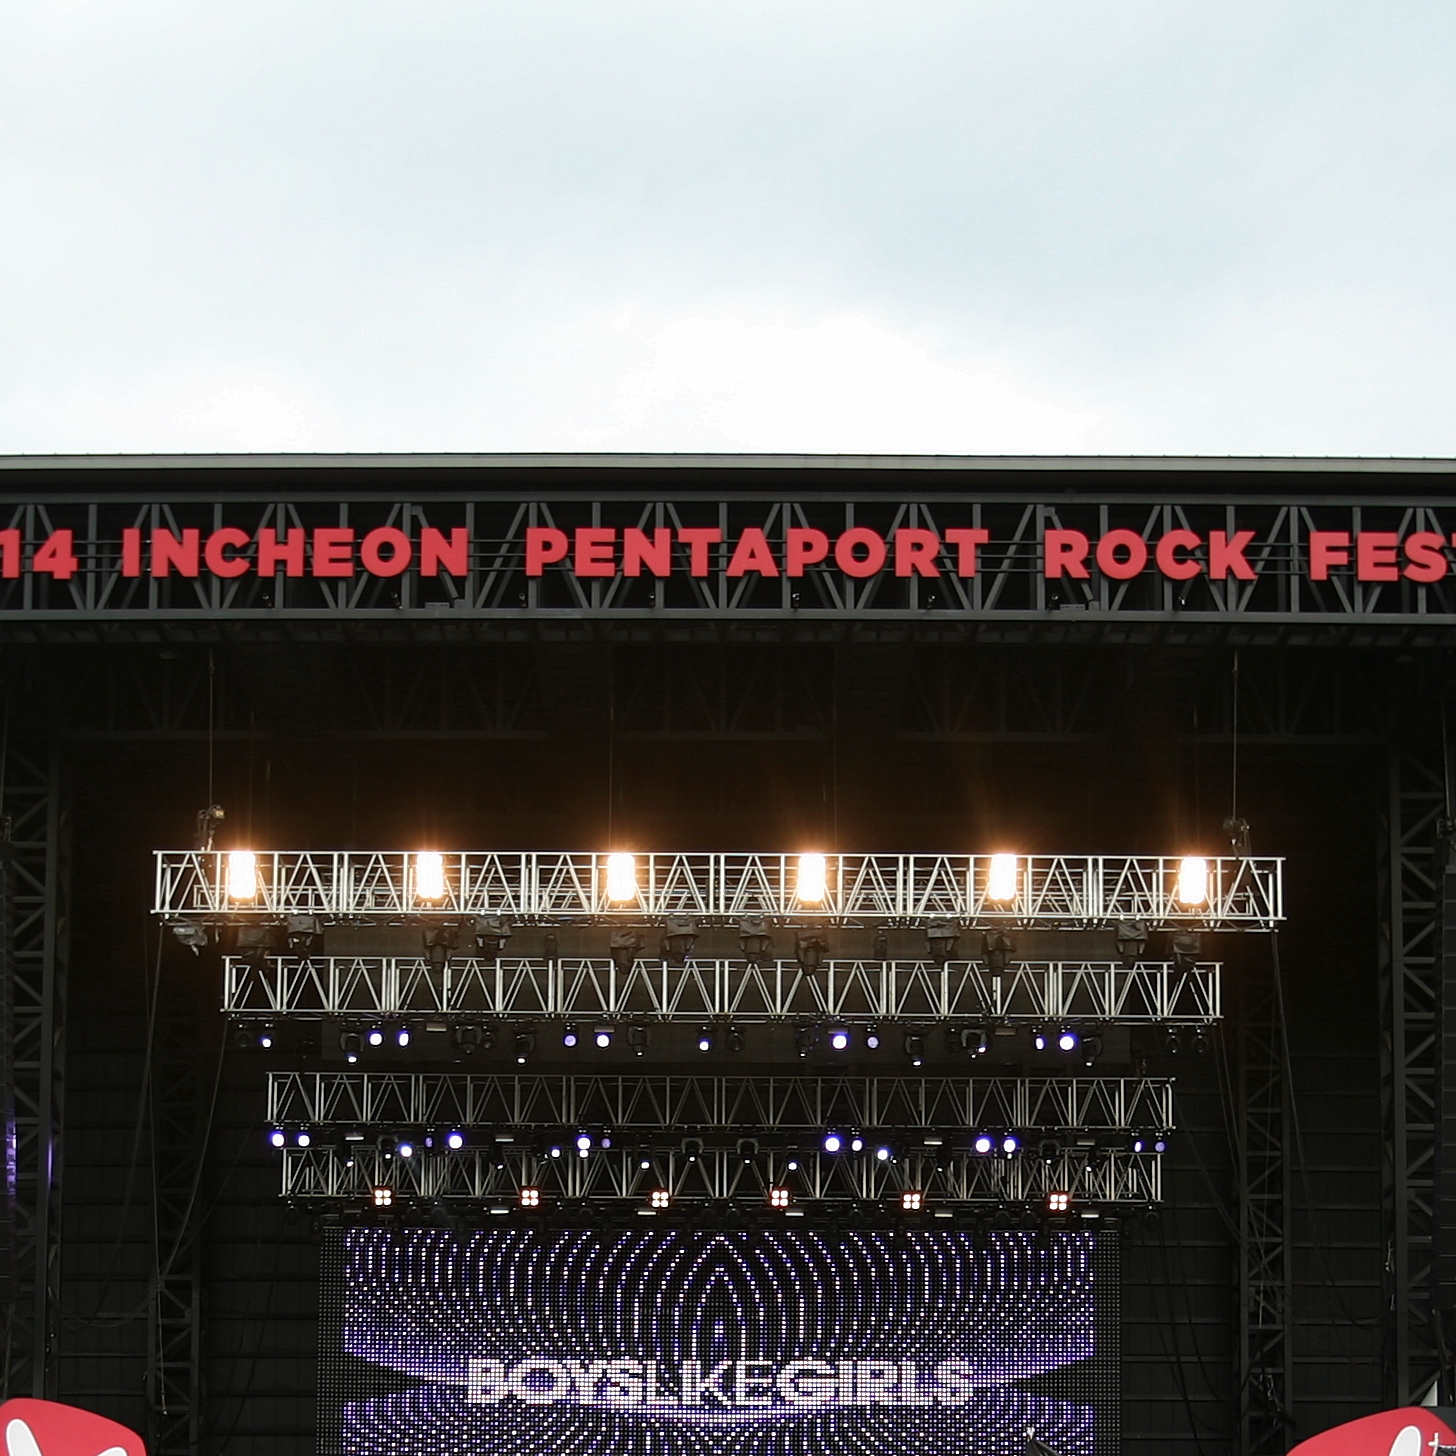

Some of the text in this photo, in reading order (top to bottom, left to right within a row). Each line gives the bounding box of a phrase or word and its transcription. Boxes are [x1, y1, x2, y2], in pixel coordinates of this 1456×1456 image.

[122, 526, 470, 578] INCHEON
[525, 526, 990, 578] PENTAPORT
[1044, 528, 1257, 580] ROCK
